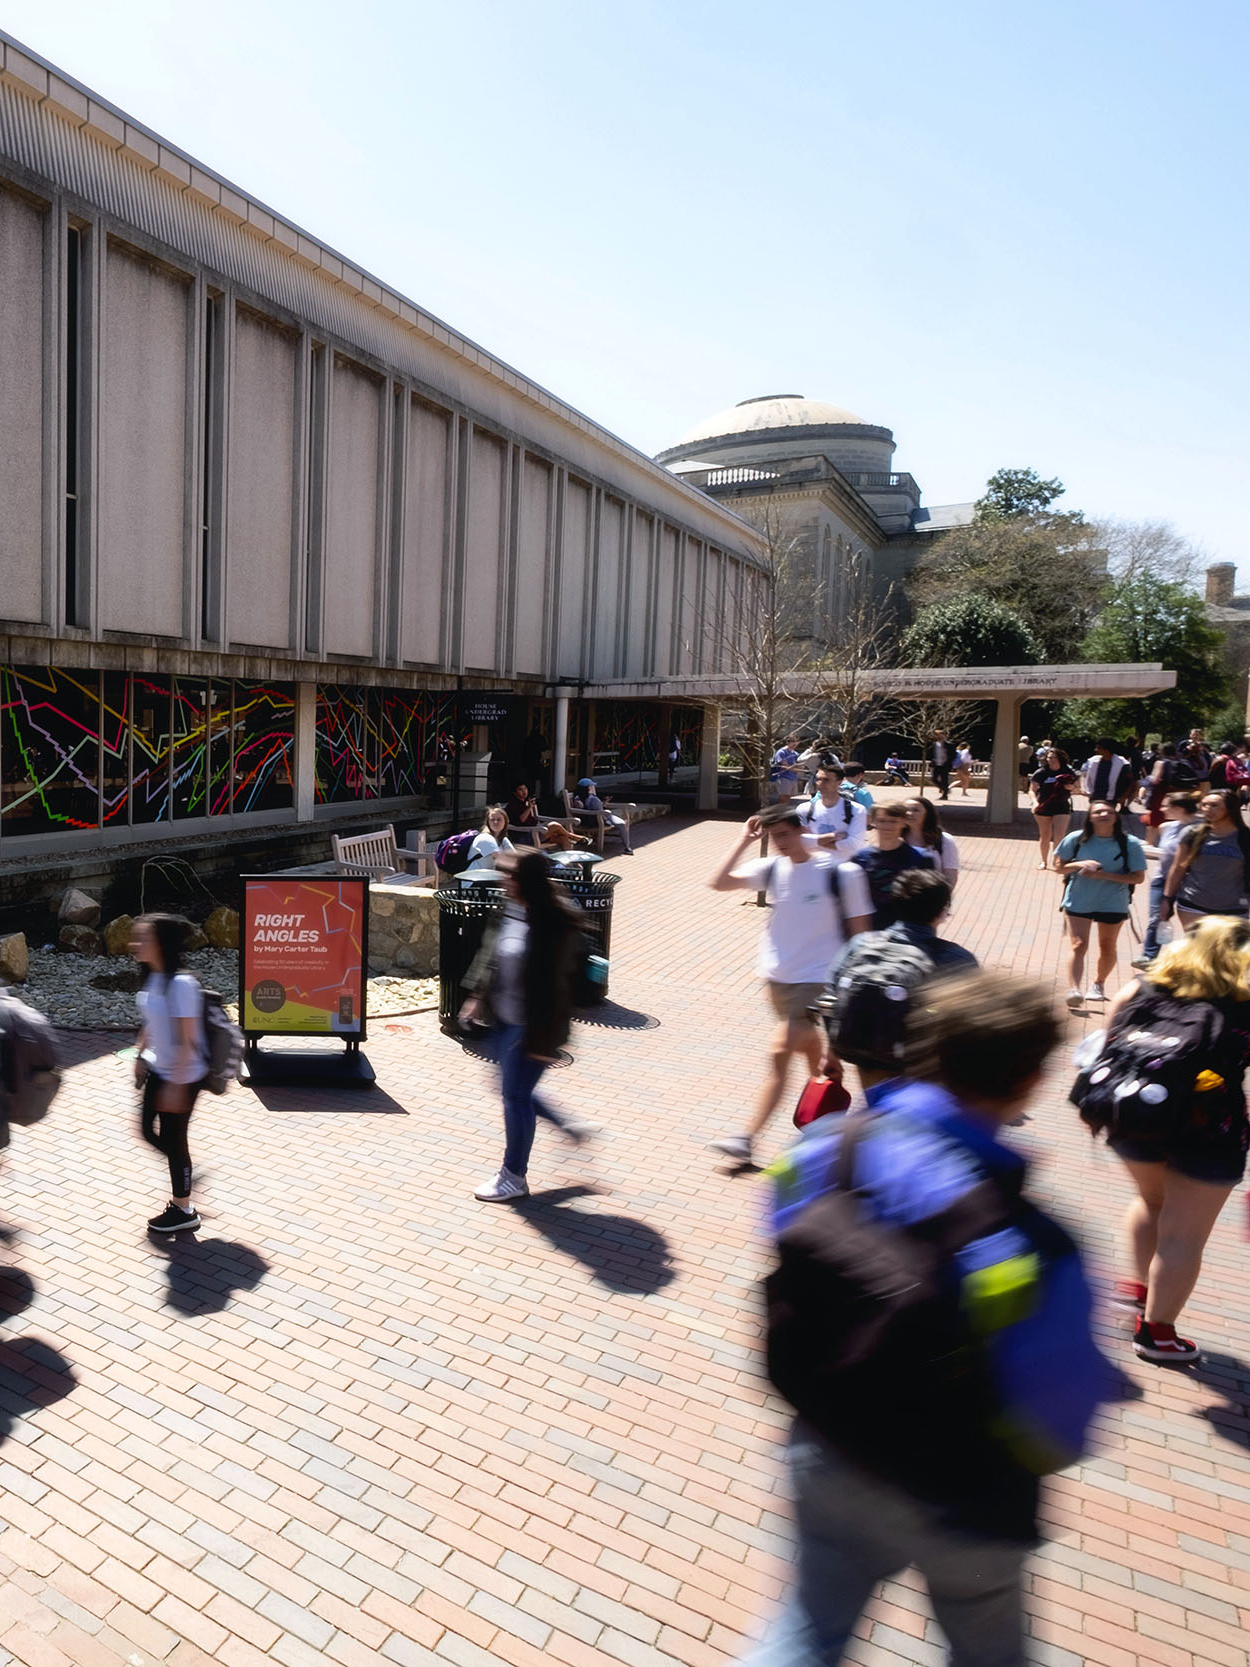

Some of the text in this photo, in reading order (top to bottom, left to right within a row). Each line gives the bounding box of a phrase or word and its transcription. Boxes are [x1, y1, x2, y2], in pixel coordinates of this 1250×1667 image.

[944, 678, 1014, 687] UNDERGRADUATE
[254, 914, 305, 927] RIGHT
[253, 930, 319, 942] ANGLES
[254, 945, 263, 953] by
[256, 987, 281, 996] ARTS
[257, 1016, 275, 1024] UNC
